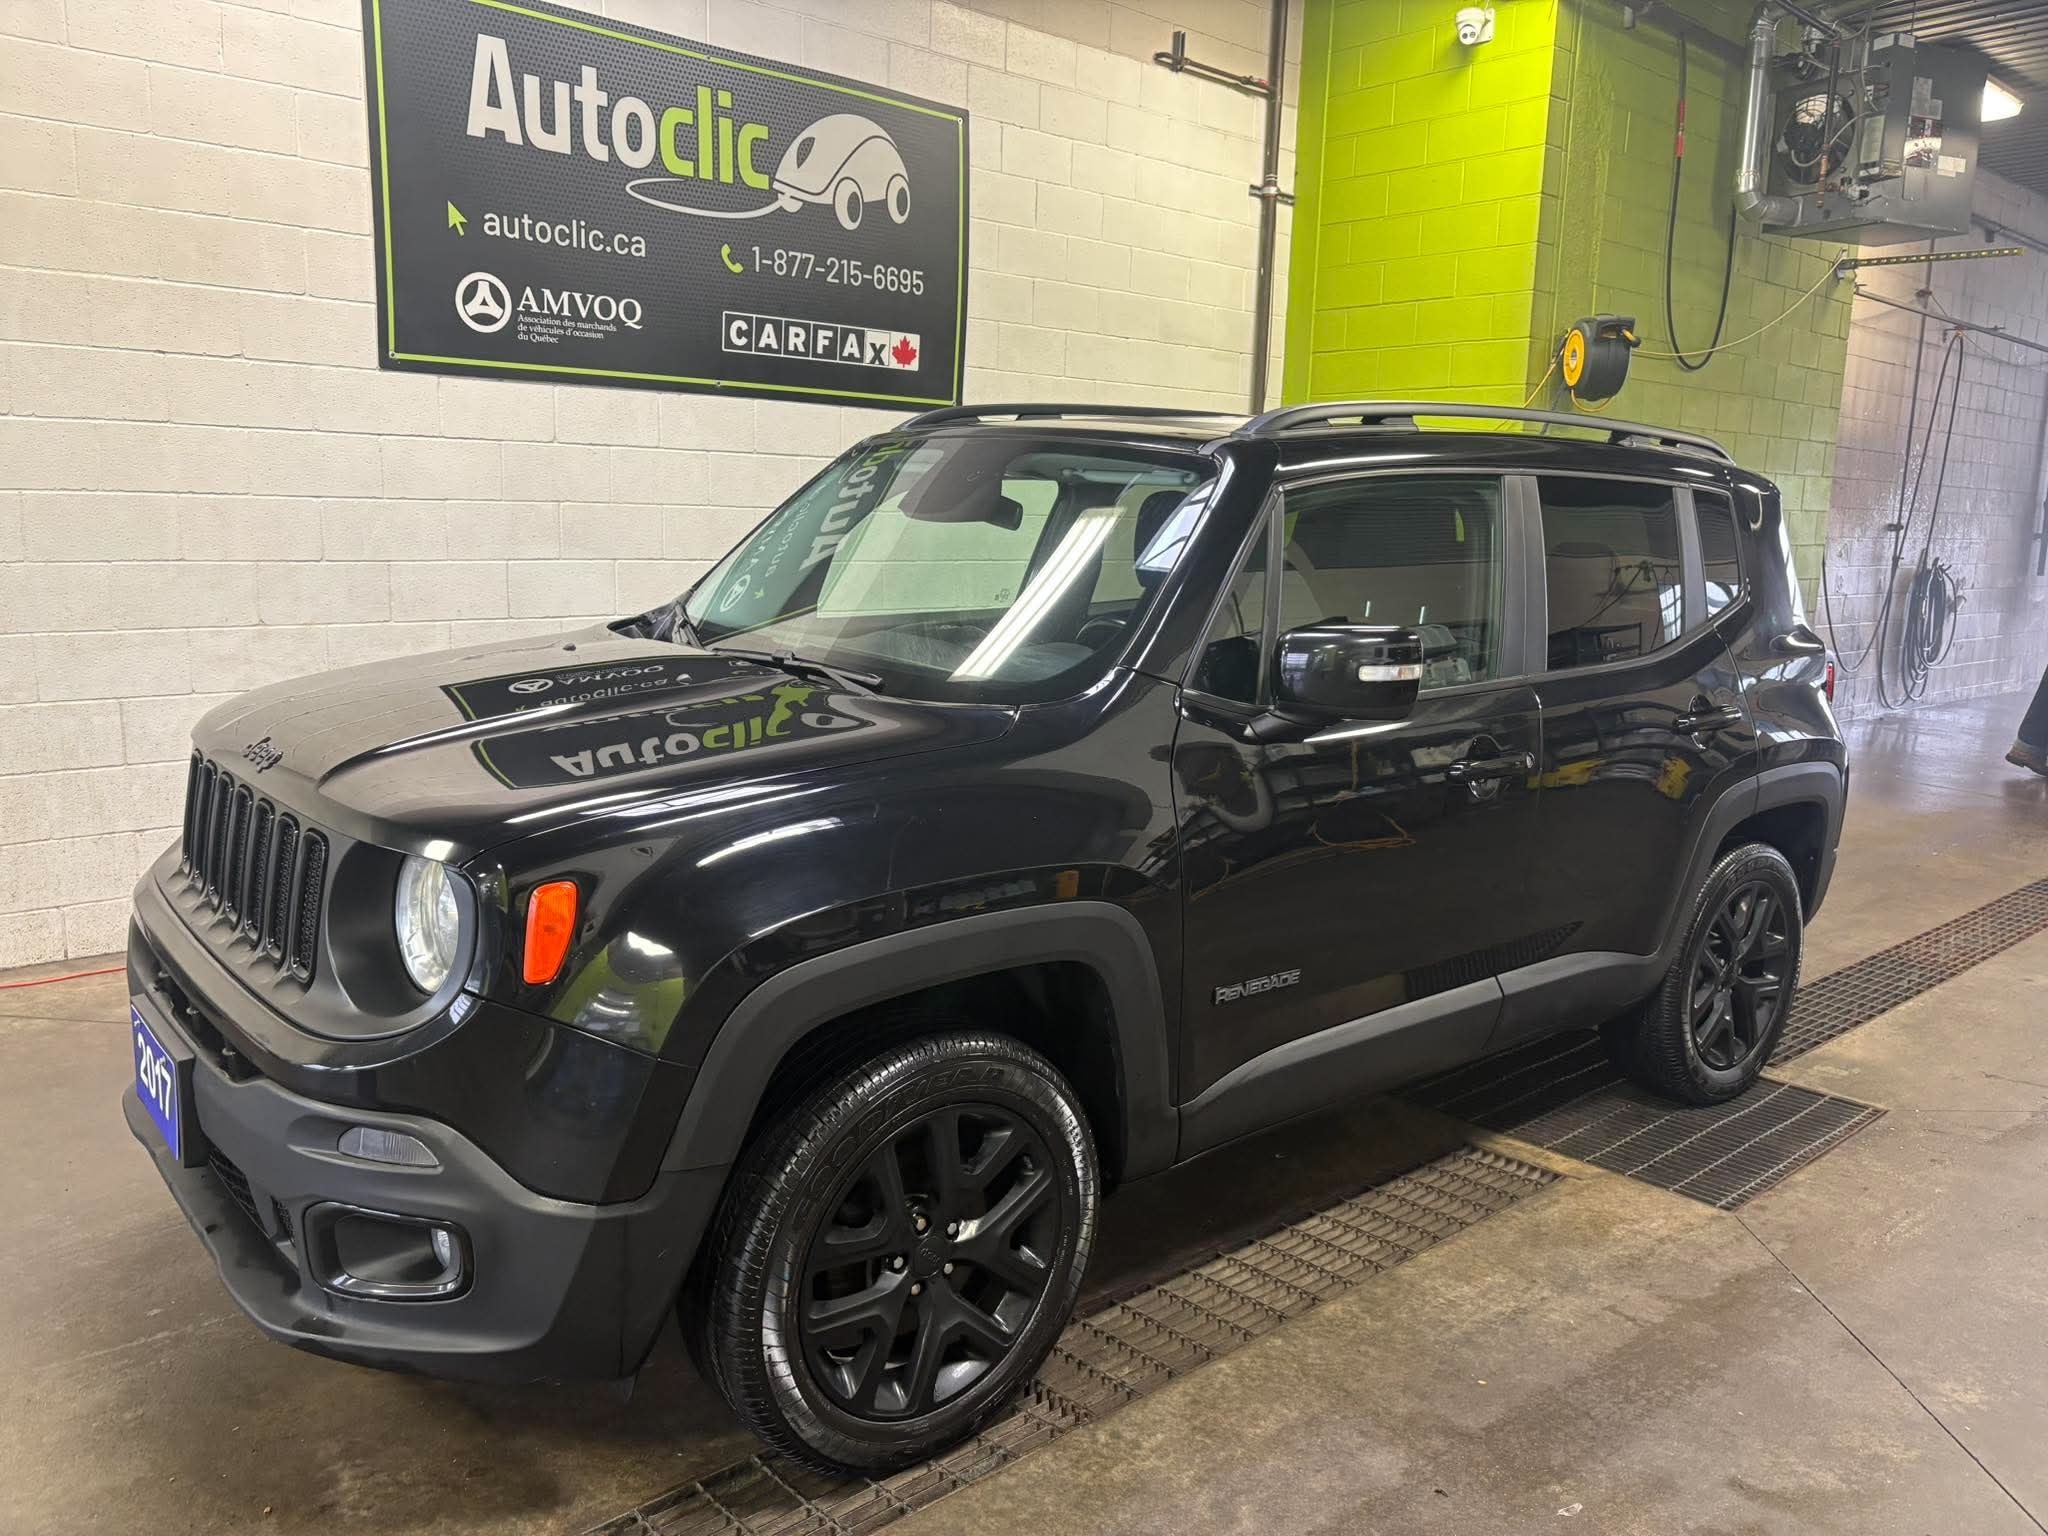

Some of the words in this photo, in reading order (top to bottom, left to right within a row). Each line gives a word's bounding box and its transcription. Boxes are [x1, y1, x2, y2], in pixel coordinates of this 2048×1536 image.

[466, 32, 770, 190] Autoclic
[483, 212, 647, 257] autoclic.ca
[751, 246, 924, 295] 1-877-215-6695
[516, 286, 644, 329] AMVOQ
[517, 314, 562, 326] Association
[562, 317, 576, 327] des
[576, 319, 618, 332] marchands
[517, 323, 528, 332] de
[529, 324, 565, 335] véhicules
[517, 332, 529, 340] du
[529, 333, 560, 344] Québec
[729, 319, 887, 366] CARFAX
[242, 736, 284, 774] Jeep
[1214, 967, 1302, 1005] RENEGADE
[137, 1031, 172, 1121] 2017
